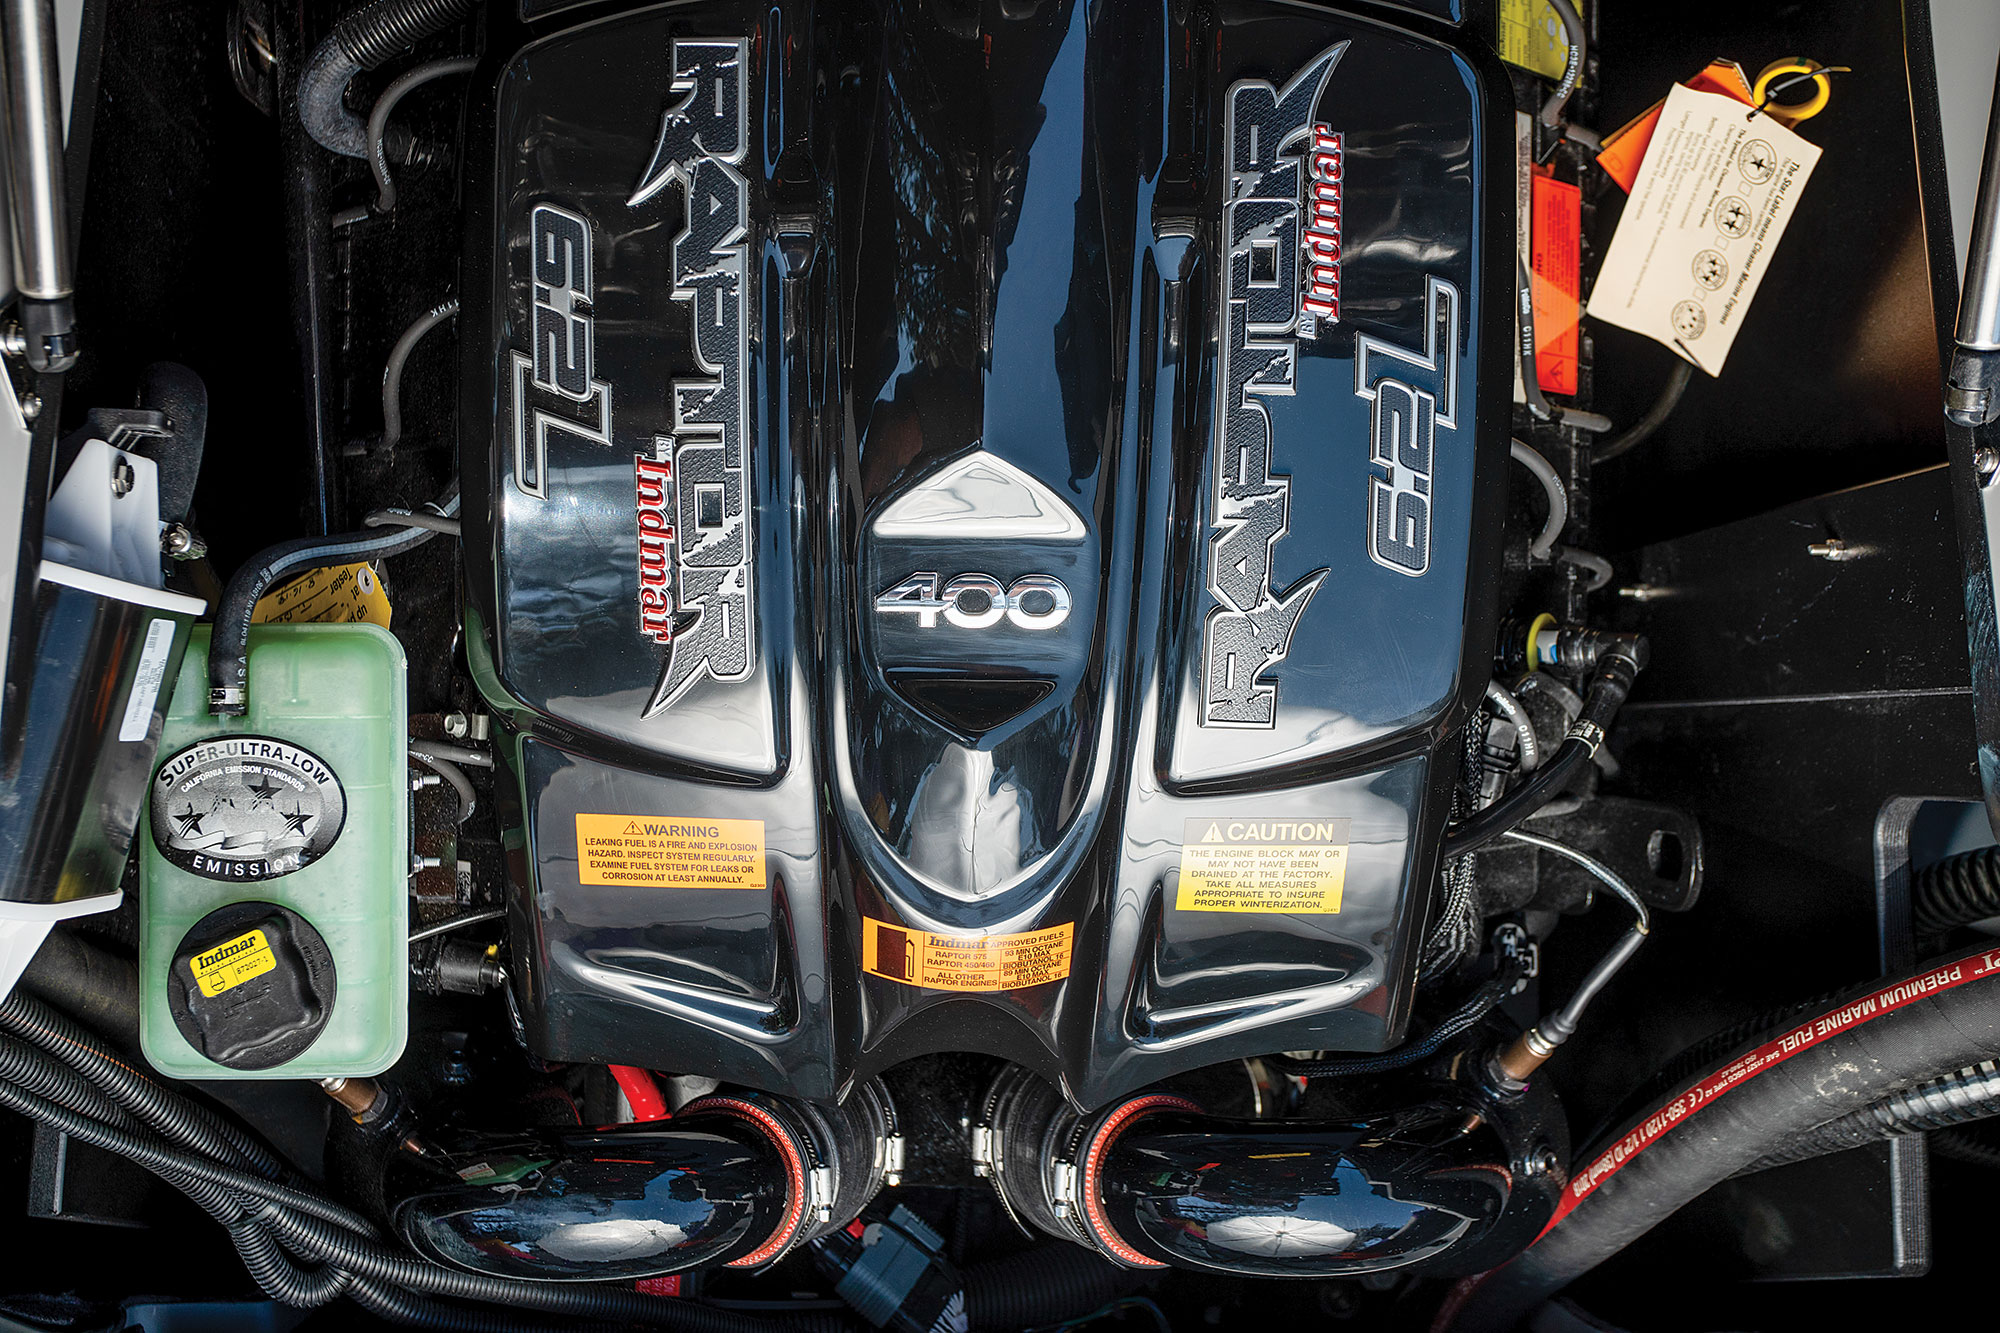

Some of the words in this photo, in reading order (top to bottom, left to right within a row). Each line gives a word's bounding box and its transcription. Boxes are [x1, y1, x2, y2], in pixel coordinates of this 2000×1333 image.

[1787, 161, 1800, 177] The
[1778, 177, 1792, 195] Star
[1768, 195, 1784, 217] Label
[1301, 122, 1343, 319] Indmar
[430, 299, 458, 318] 11HK
[628, 36, 755, 720] RAPTOR
[1197, 40, 1352, 729] RAPTOR
[635, 454, 675, 642] Indmar
[330, 567, 353, 595] Tester
[352, 584, 360, 602] at
[874, 572, 1072, 629] 400
[159, 742, 329, 787] SUPER-ULTRA-LOW
[181, 768, 222, 792] CALIFORNIA
[225, 765, 261, 773] EMISSION
[262, 767, 305, 791] STANDARDS
[644, 824, 719, 837] WARNING
[1227, 823, 1333, 841] CAUTION
[585, 838, 622, 846] LEAKING
[709, 843, 757, 851] EXPLOSION
[192, 853, 300, 875] EMISSION
[588, 850, 626, 858] HAZARD.
[628, 851, 663, 860] INSPECT
[703, 854, 755, 862] REGULARLY.
[590, 861, 628, 869] EXAMINE
[654, 863, 688, 871] SYSTEM
[602, 872, 653, 881] CORROSION
[668, 874, 695, 882] LEAST
[1194, 900, 1236, 908] PROPER
[1240, 900, 1322, 908] WINTERIZATION.
[929, 936, 989, 949] Indmar
[991, 938, 1036, 948] APPROVED
[1039, 931, 1064, 942] FUELS
[1032, 940, 1063, 952] OCTANE
[197, 935, 256, 970] Indmar
[936, 951, 971, 959] RAPTOR
[1034, 950, 1050, 958] MAX
[927, 959, 962, 968] RAPTOR
[1003, 956, 1053, 970] BIOBUTANOL
[1031, 960, 1062, 972] OCTANE
[924, 976, 958, 986] RAPTOR
[1002, 975, 1052, 988] BIOBUTANOL
[1032, 969, 1049, 978] MAX
[1880, 965, 1962, 1010] PREMIUM
[1815, 998, 1877, 1037] MARINE
[1777, 1025, 1815, 1053] FUEL
[1764, 1049, 1780, 1062] SAE
[1726, 1067, 1746, 1082] USCG
[1712, 1078, 1728, 1092] TYPE
